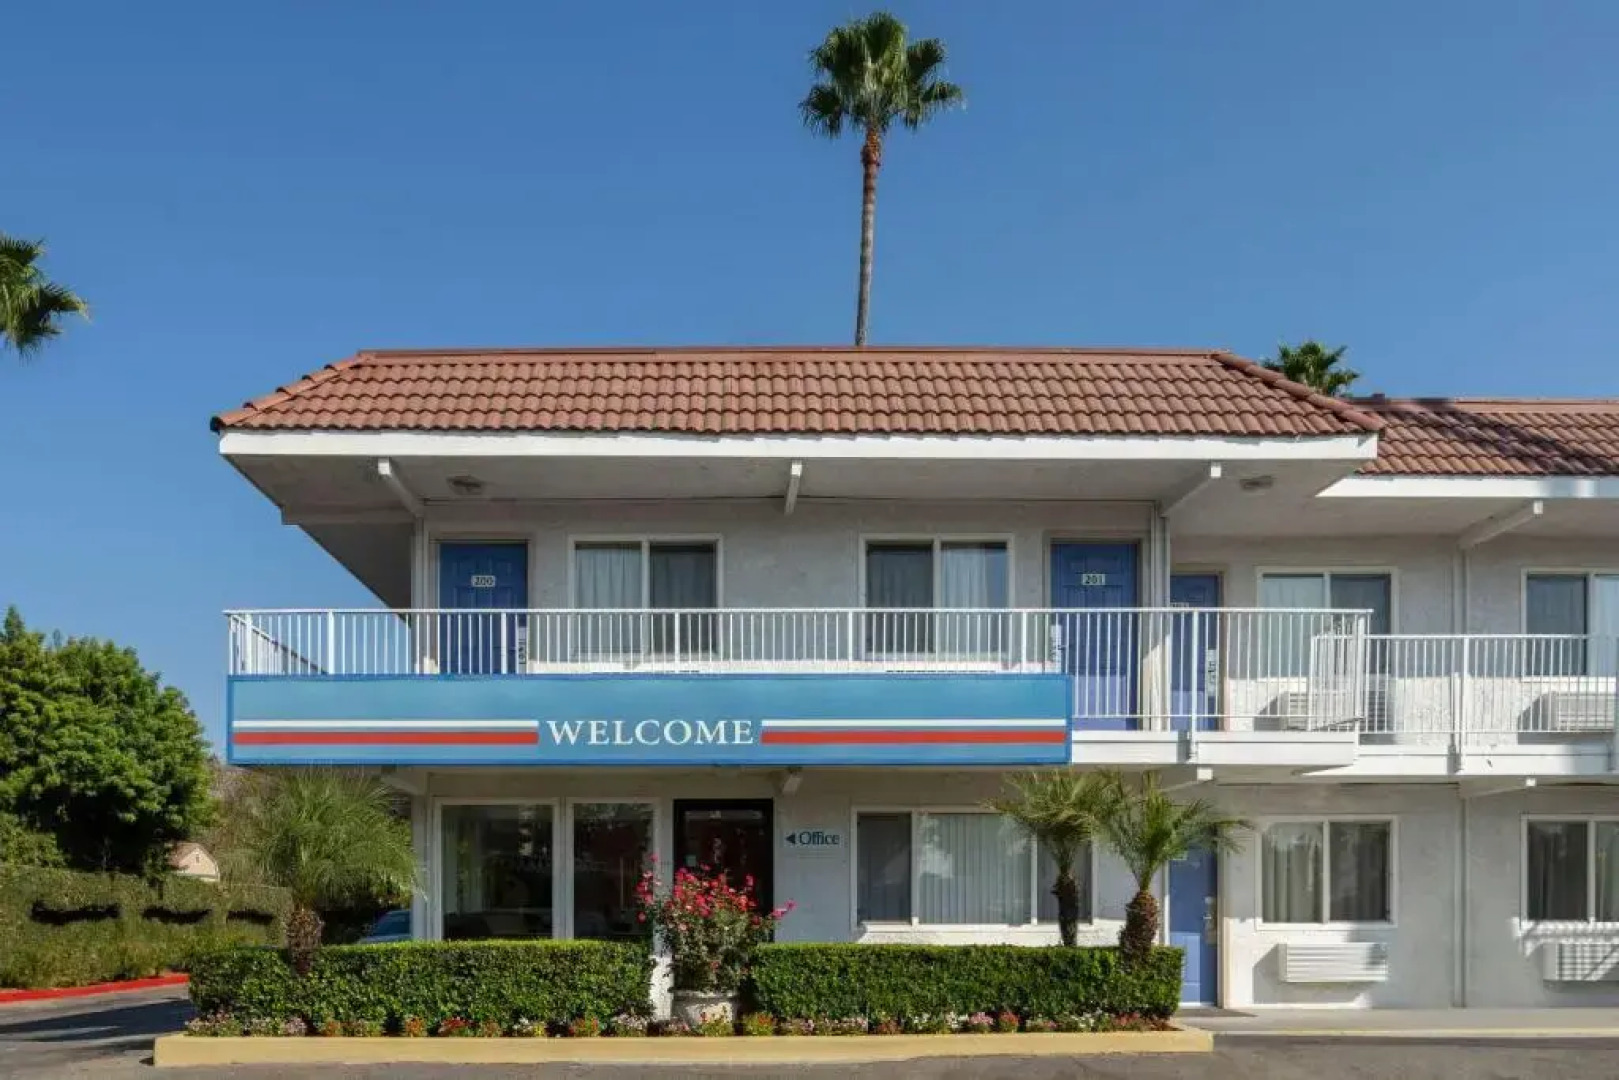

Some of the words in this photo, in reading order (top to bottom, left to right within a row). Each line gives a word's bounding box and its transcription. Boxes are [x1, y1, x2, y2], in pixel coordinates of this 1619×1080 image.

[1085, 574, 1103, 585] 201
[546, 719, 754, 746] WELCOME
[799, 831, 840, 845] Office
